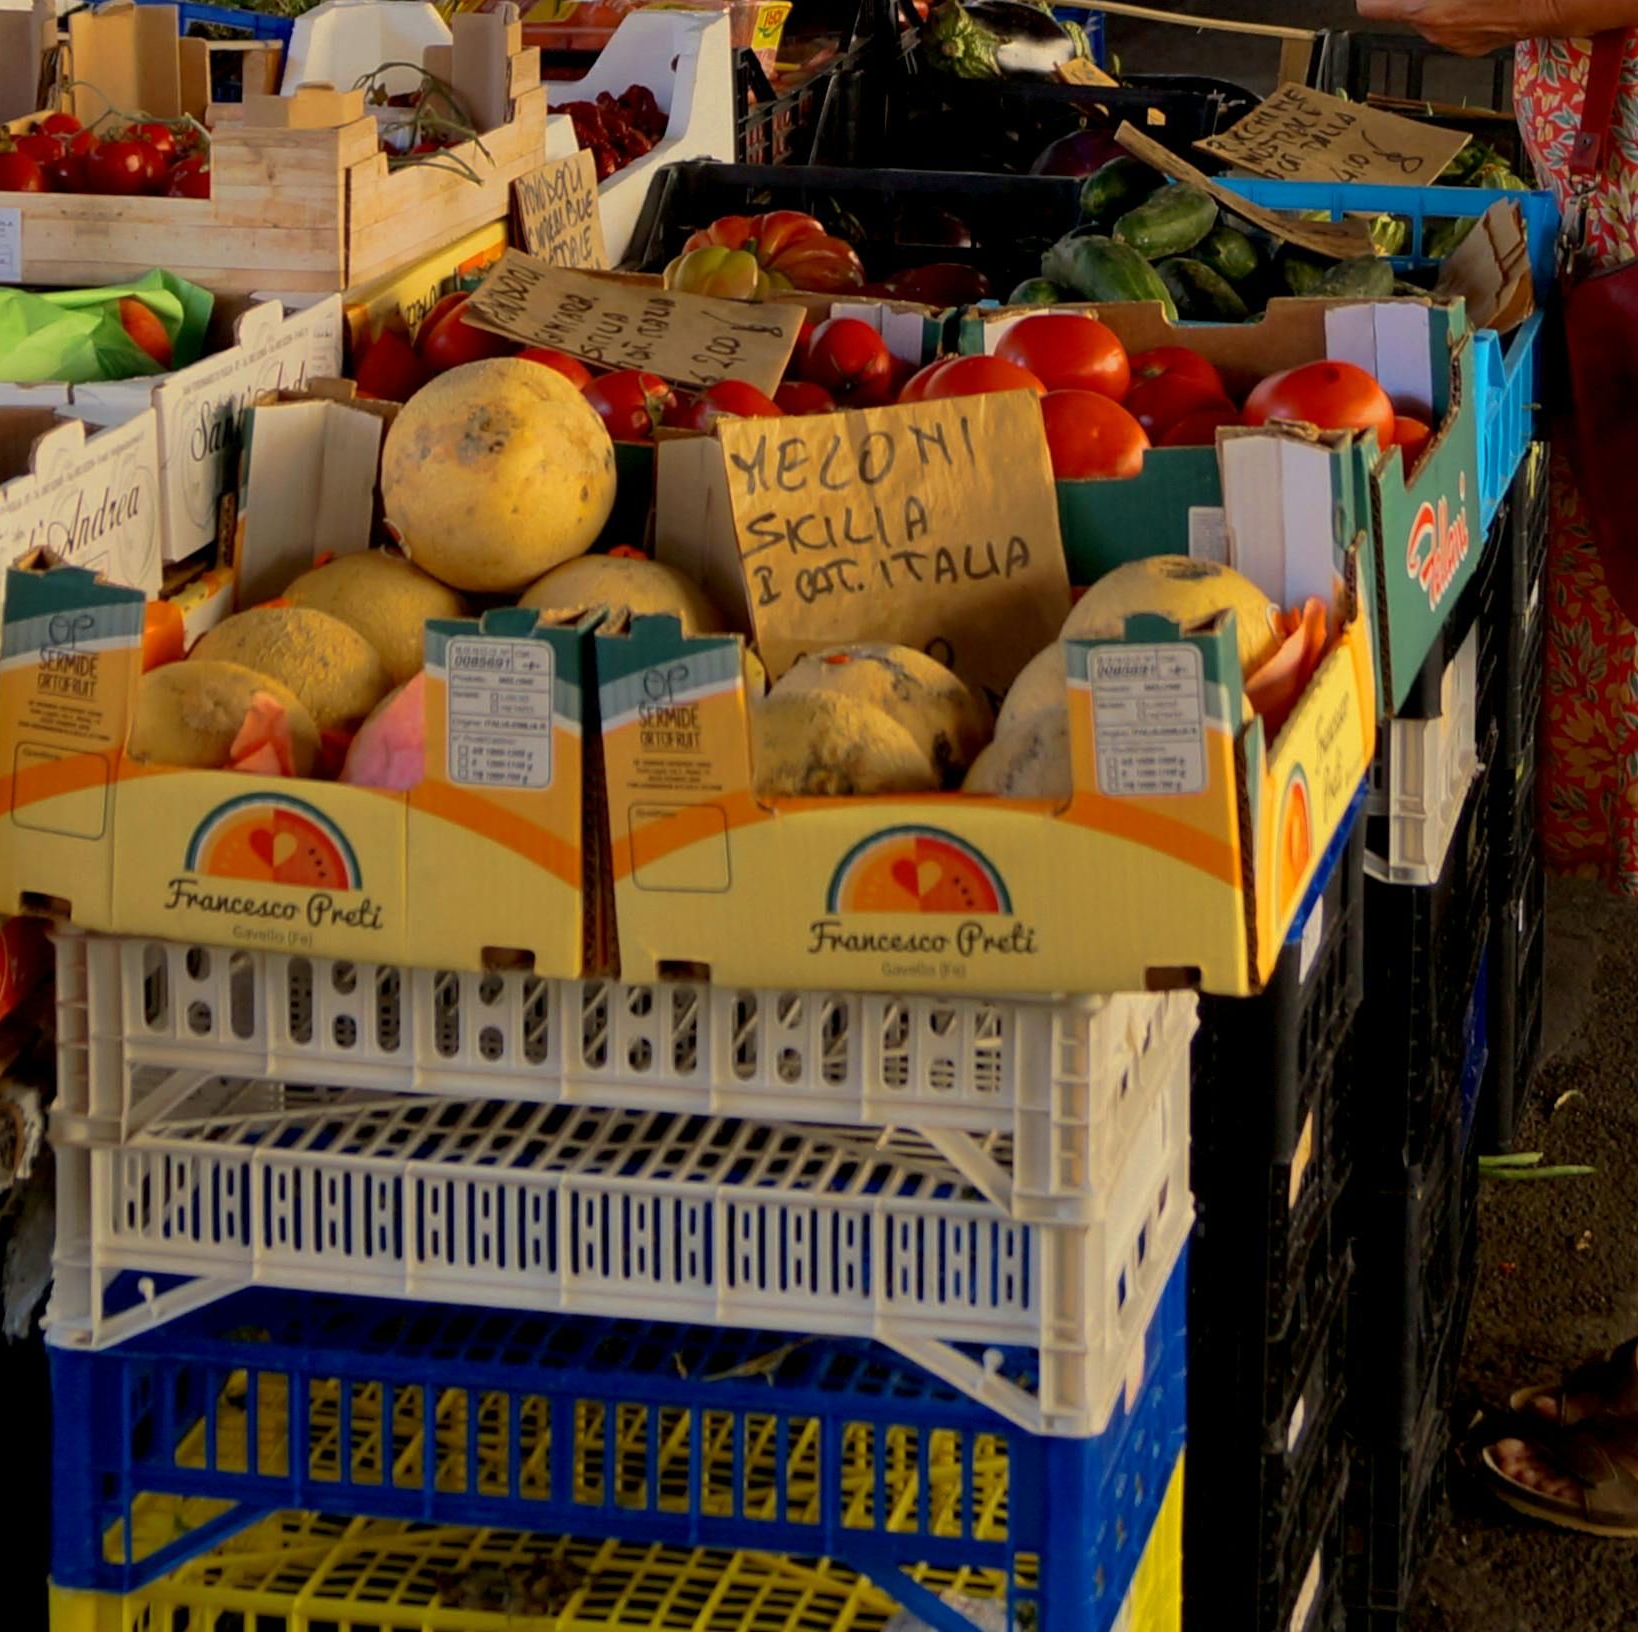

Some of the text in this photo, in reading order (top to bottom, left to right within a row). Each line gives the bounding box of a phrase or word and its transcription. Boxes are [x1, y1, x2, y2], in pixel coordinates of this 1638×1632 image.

[730, 416, 976, 496] MELONI
[46, 485, 140, 558] Andrea
[795, 558, 865, 604] CAT.
[880, 535, 1031, 589] ITALIA
[49, 614, 95, 649] OP
[38, 645, 99, 680] SERMIDE
[37, 673, 96, 699] ORTOFRUIT
[643, 665, 689, 703] OP
[638, 701, 700, 730] SERMIDE
[640, 730, 700, 749] ORTOFRUIT
[164, 878, 383, 930] Francesco Preti
[807, 920, 1038, 958] Francesco Preti
